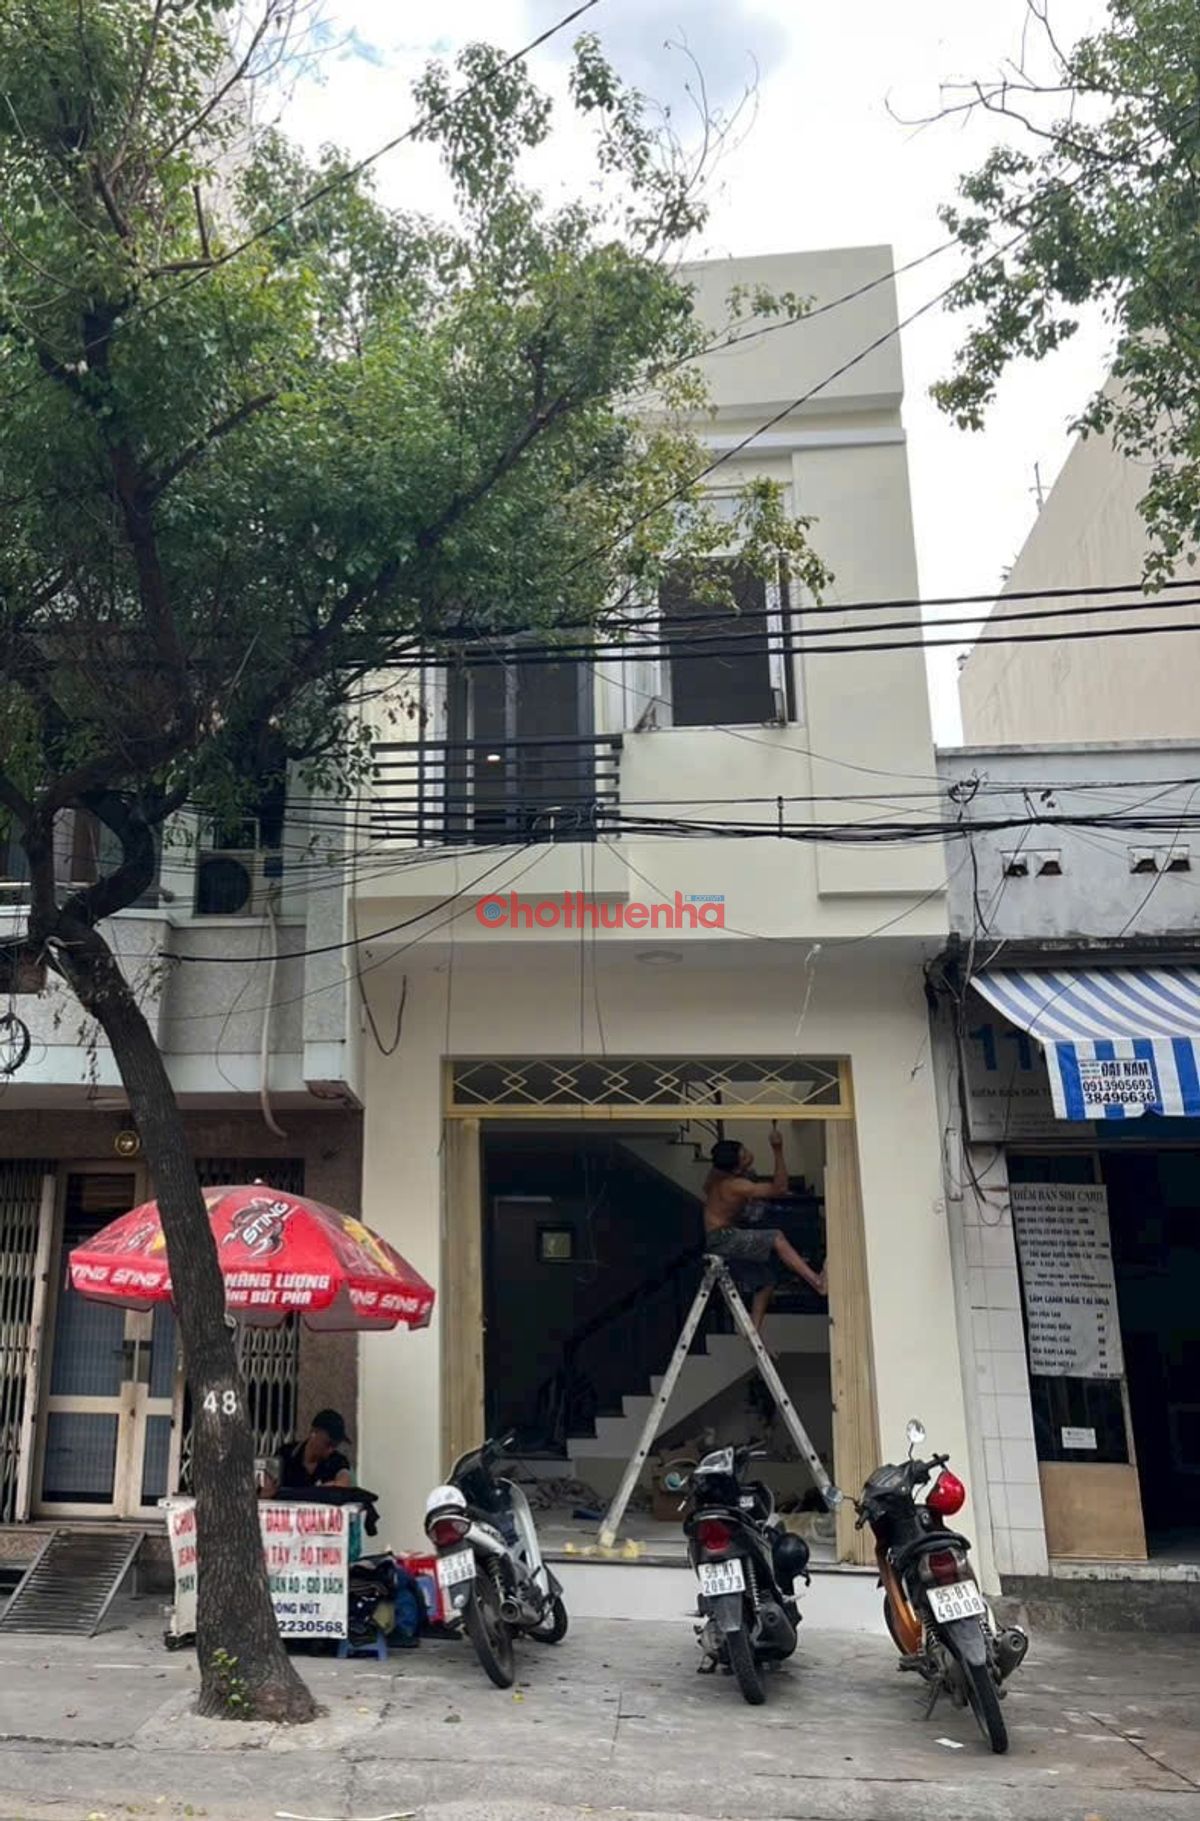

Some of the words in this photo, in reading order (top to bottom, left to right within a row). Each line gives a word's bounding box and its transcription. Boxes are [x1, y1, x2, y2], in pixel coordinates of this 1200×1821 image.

[1083, 1080, 1153, 1092] 0913905693
[1085, 1091, 1156, 1104] 38496636
[242, 1202, 289, 1245] STING
[72, 1264, 111, 1281] TING
[203, 1390, 237, 1414] 48
[278, 1620, 344, 1634] 2230568
